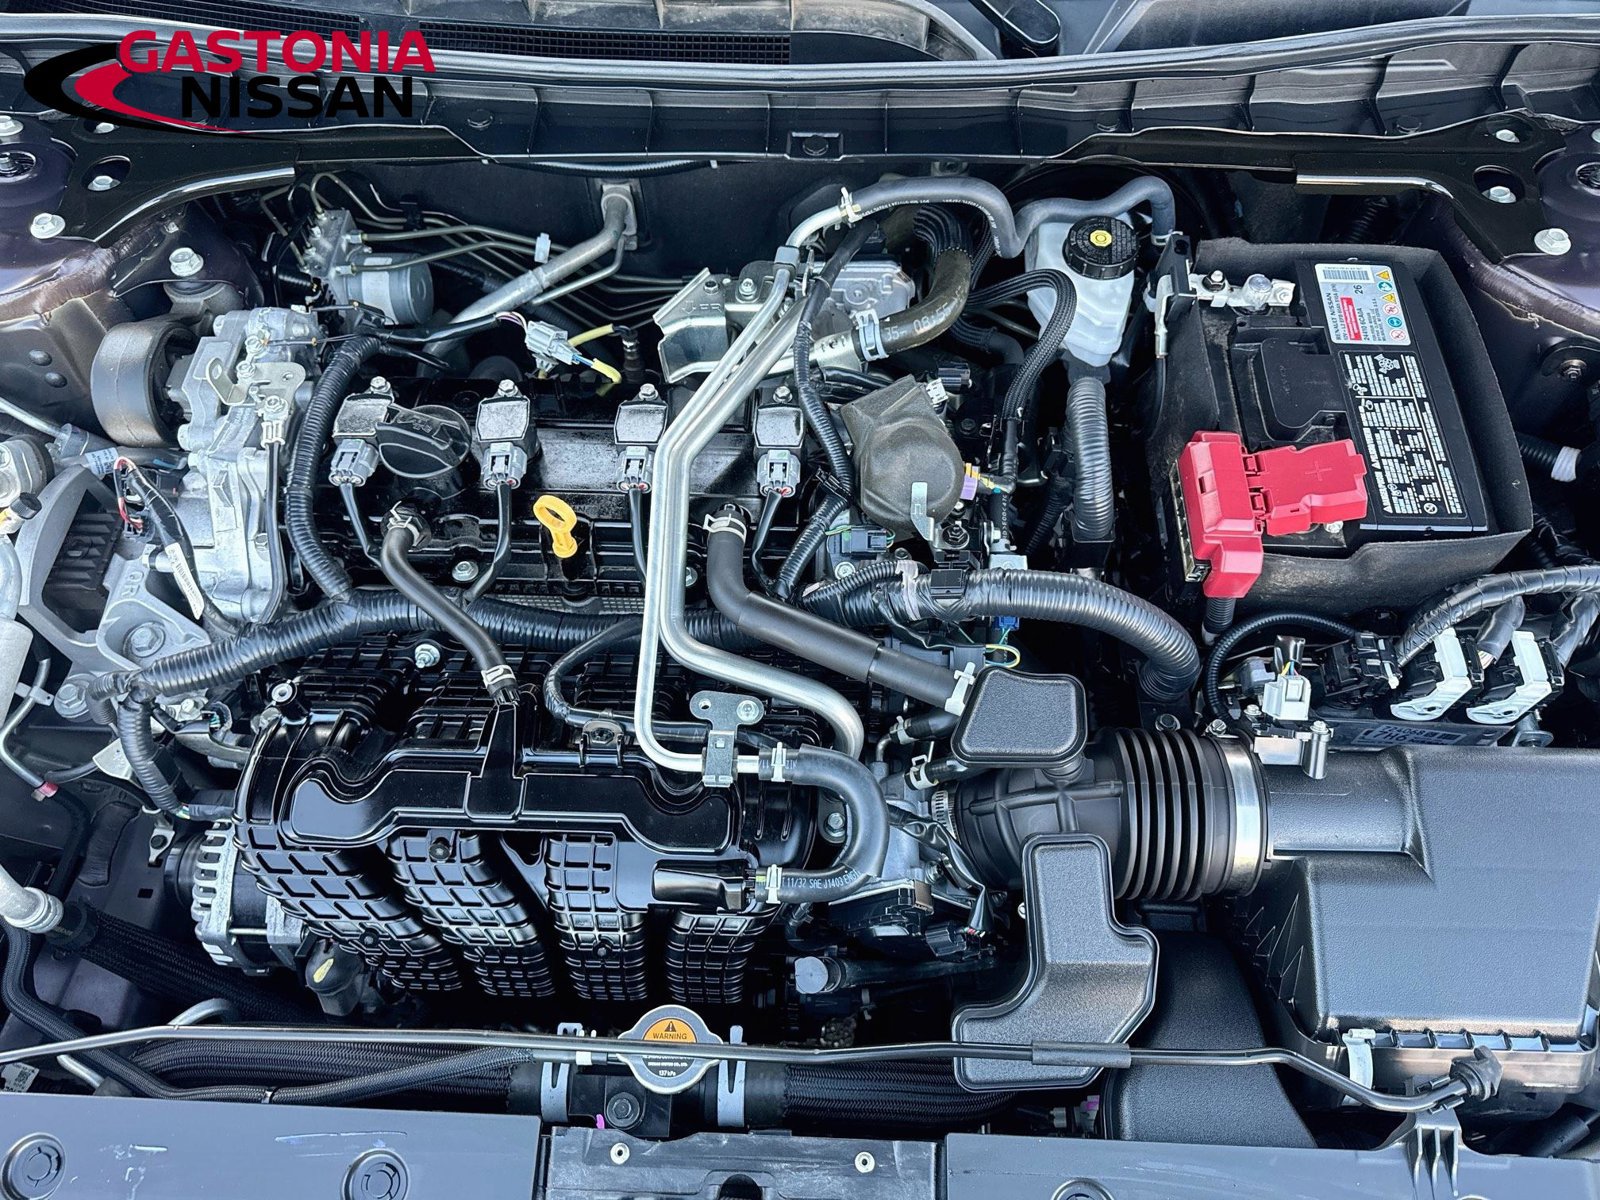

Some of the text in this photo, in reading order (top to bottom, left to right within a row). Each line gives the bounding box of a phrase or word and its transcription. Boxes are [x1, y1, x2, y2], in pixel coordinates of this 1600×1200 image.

[1353, 284, 1364, 294] 26
[1326, 293, 1335, 315] NISSAN
[1332, 318, 1341, 340] RENAULT
[809, 878, 822, 889] SAE
[823, 876, 844, 889] J1403
[652, 1032, 687, 1040] WARNING
